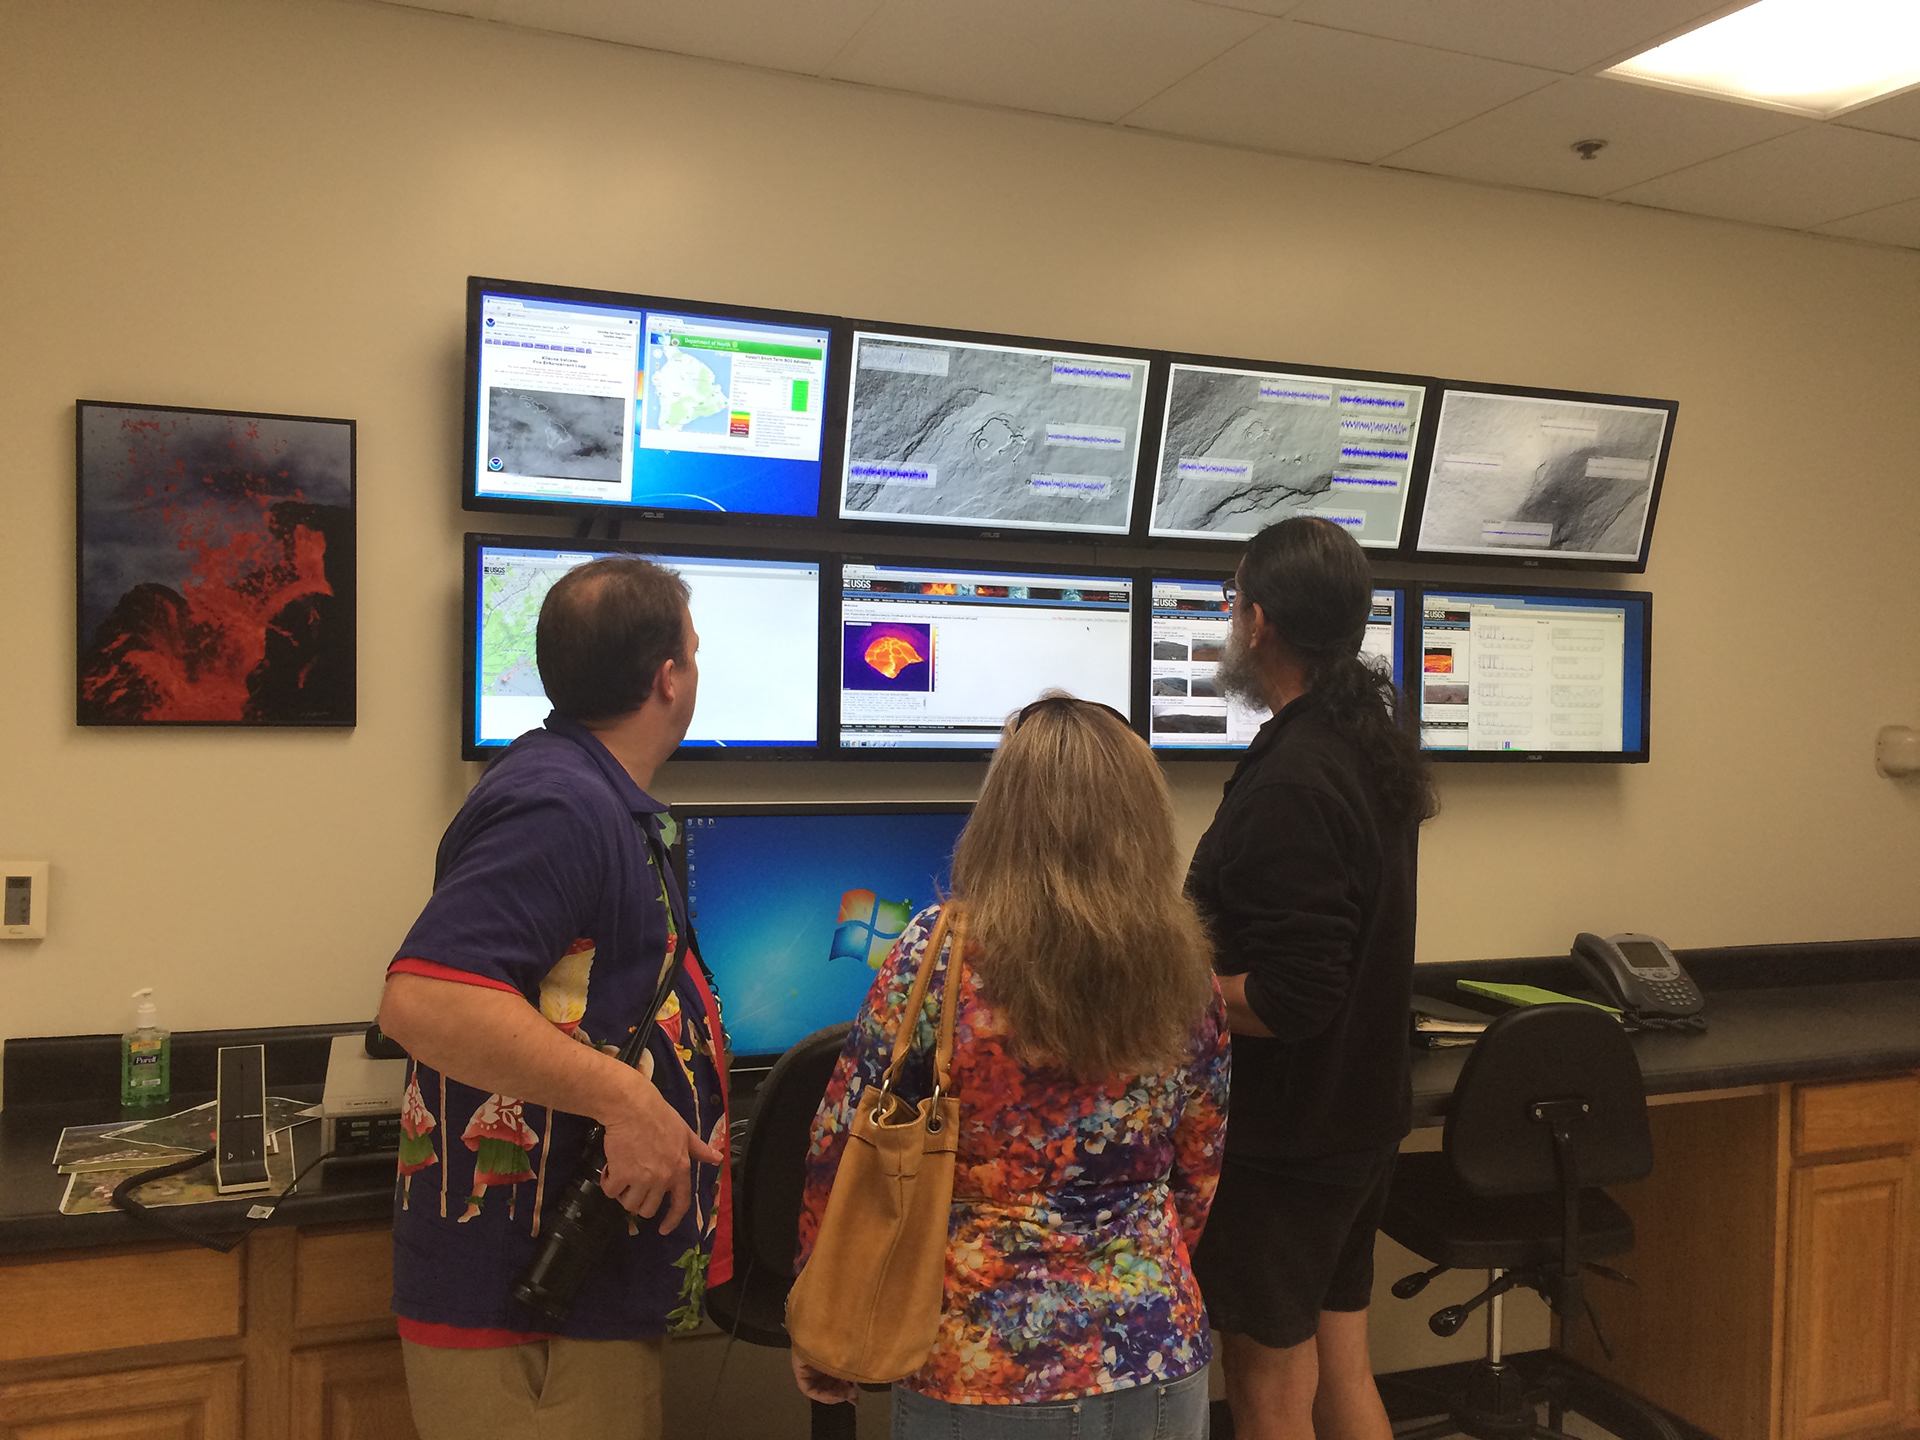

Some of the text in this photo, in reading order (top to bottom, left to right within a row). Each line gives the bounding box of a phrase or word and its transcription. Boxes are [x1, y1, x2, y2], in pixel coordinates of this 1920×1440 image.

[641, 511, 665, 519] ASUS
[851, 580, 871, 589] USGS
[1160, 599, 1177, 607] USGS
[1430, 610, 1446, 618] USGS
